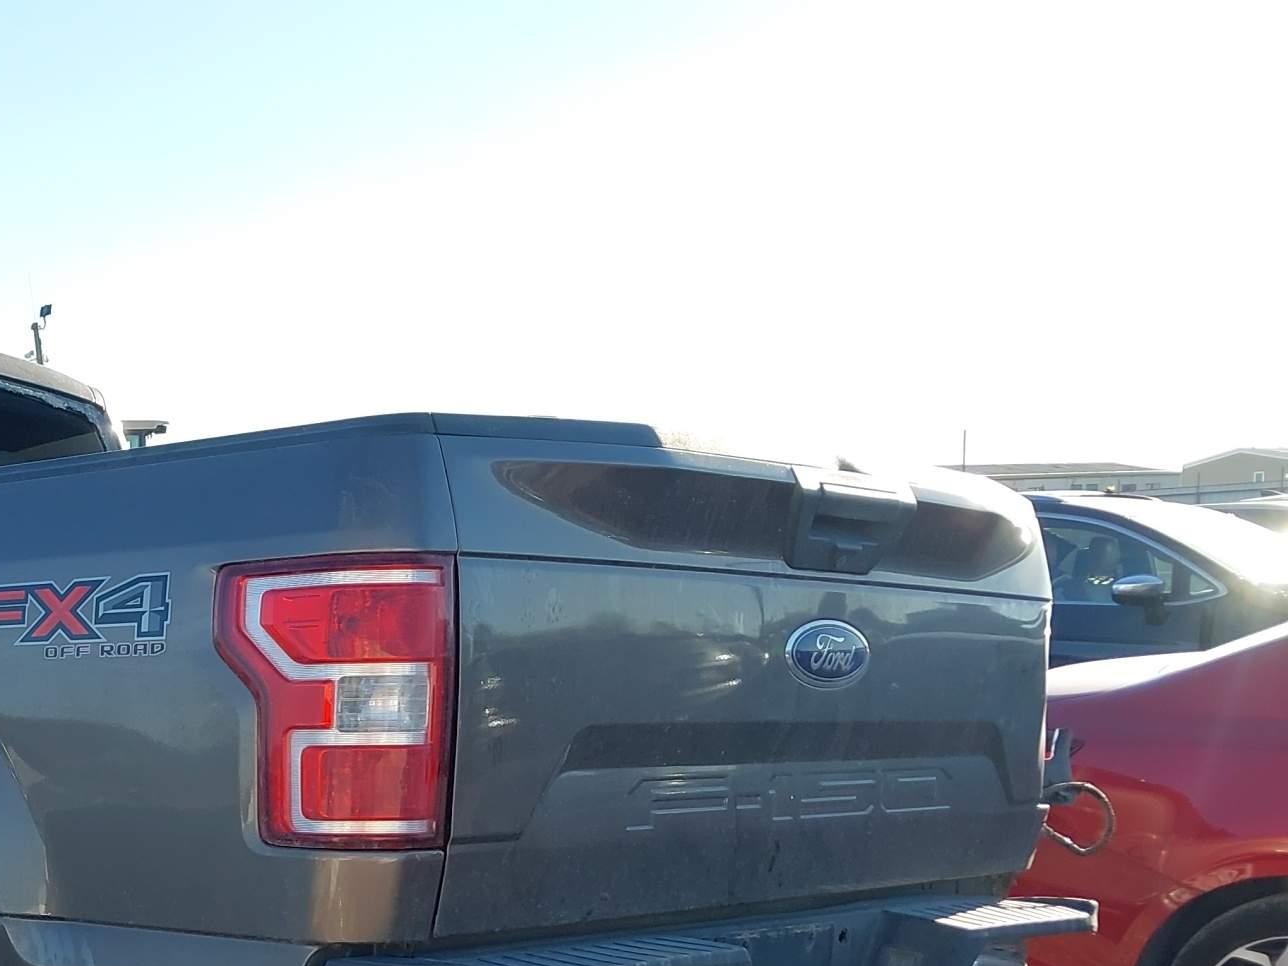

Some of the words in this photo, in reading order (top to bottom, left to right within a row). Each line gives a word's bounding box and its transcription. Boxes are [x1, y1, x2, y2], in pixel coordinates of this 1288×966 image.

[44, 644, 91, 660] OFF
[99, 641, 166, 658] ROAD
[810, 633, 856, 672] Ford
[626, 767, 953, 831] F-150
